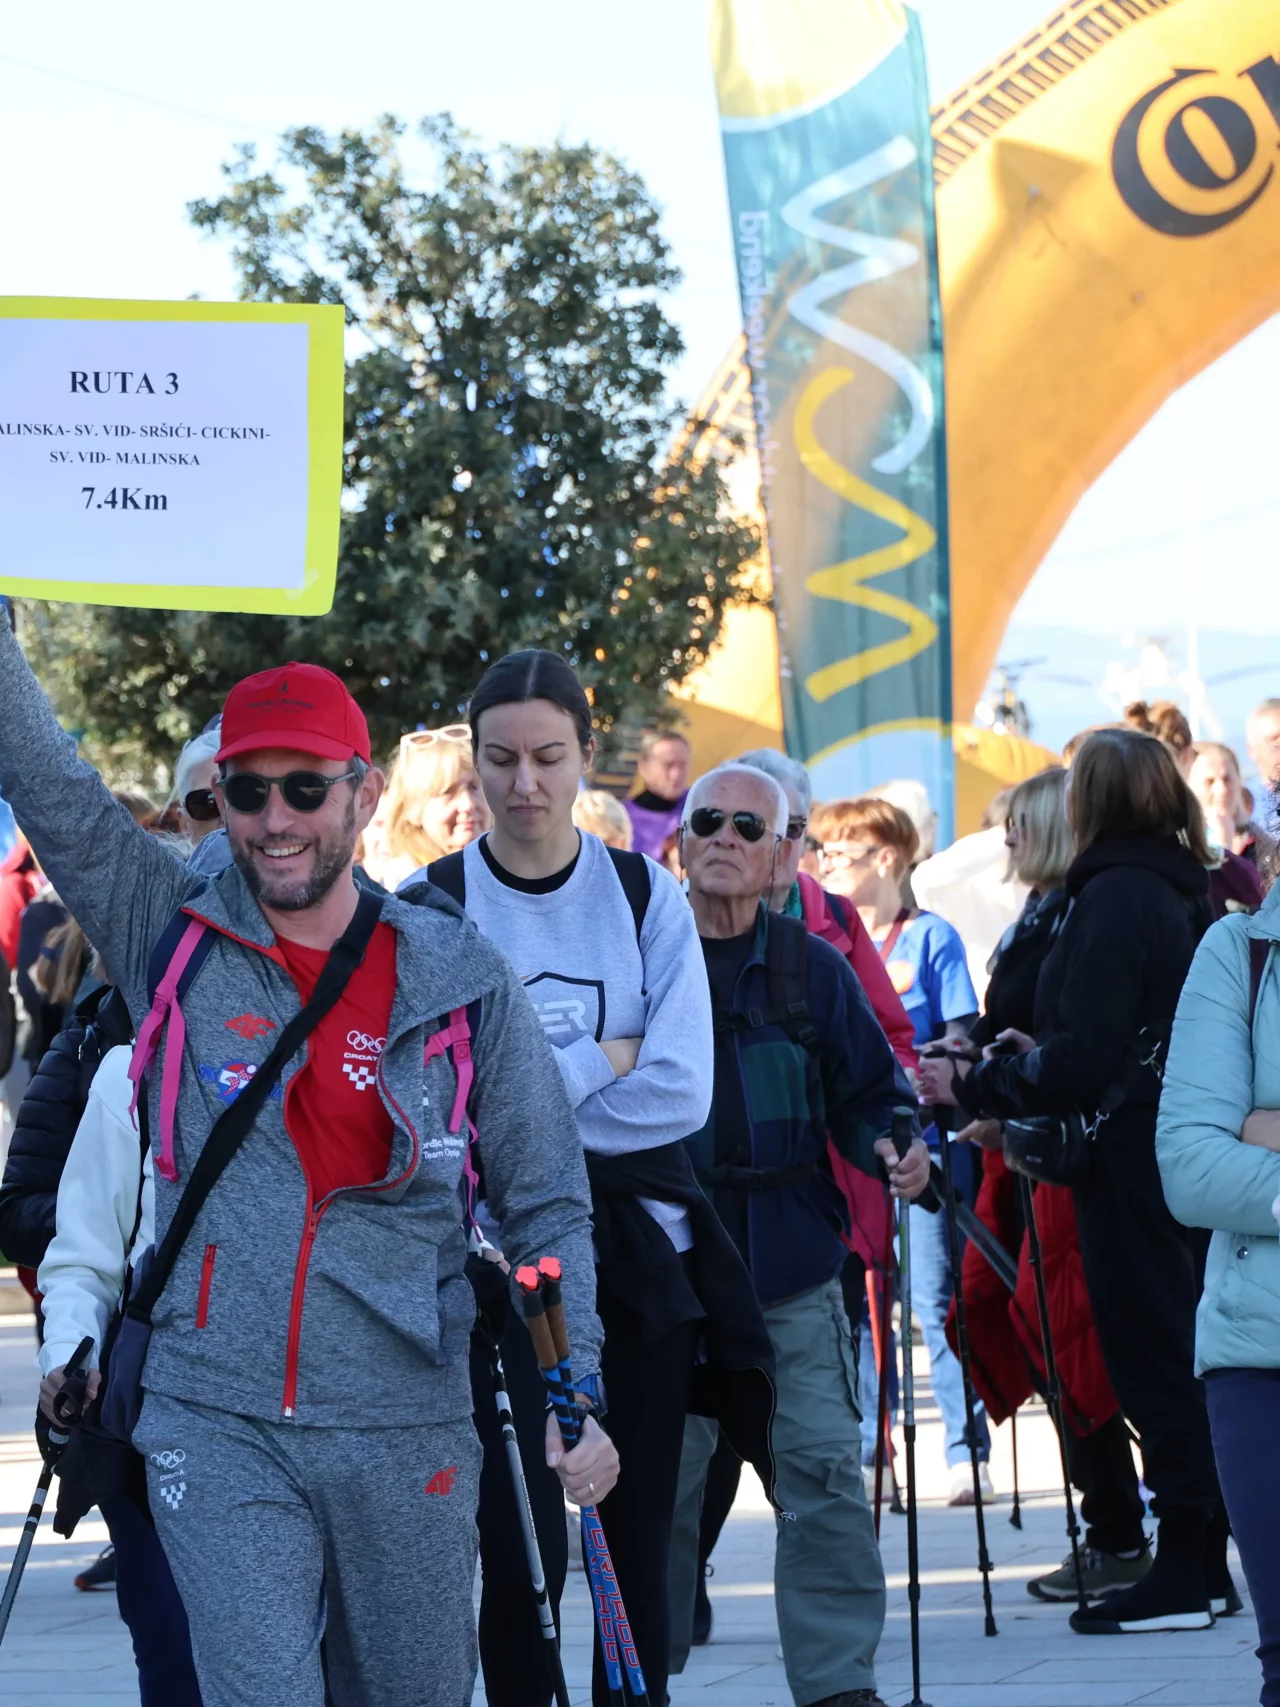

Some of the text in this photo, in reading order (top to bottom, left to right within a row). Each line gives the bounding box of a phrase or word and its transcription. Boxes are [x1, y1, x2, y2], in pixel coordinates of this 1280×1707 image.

[69, 371, 180, 395] RUTA 3
[74, 424, 98, 437] SV.
[103, 424, 137, 437] VID-
[140, 422, 198, 438] SRŠIĆI-
[201, 427, 271, 439] CICKINI-
[49, 451, 200, 465] SV. VID- MALINSKA
[81, 487, 169, 511] 7.4Km
[343, 1052, 378, 1062] CROAT
